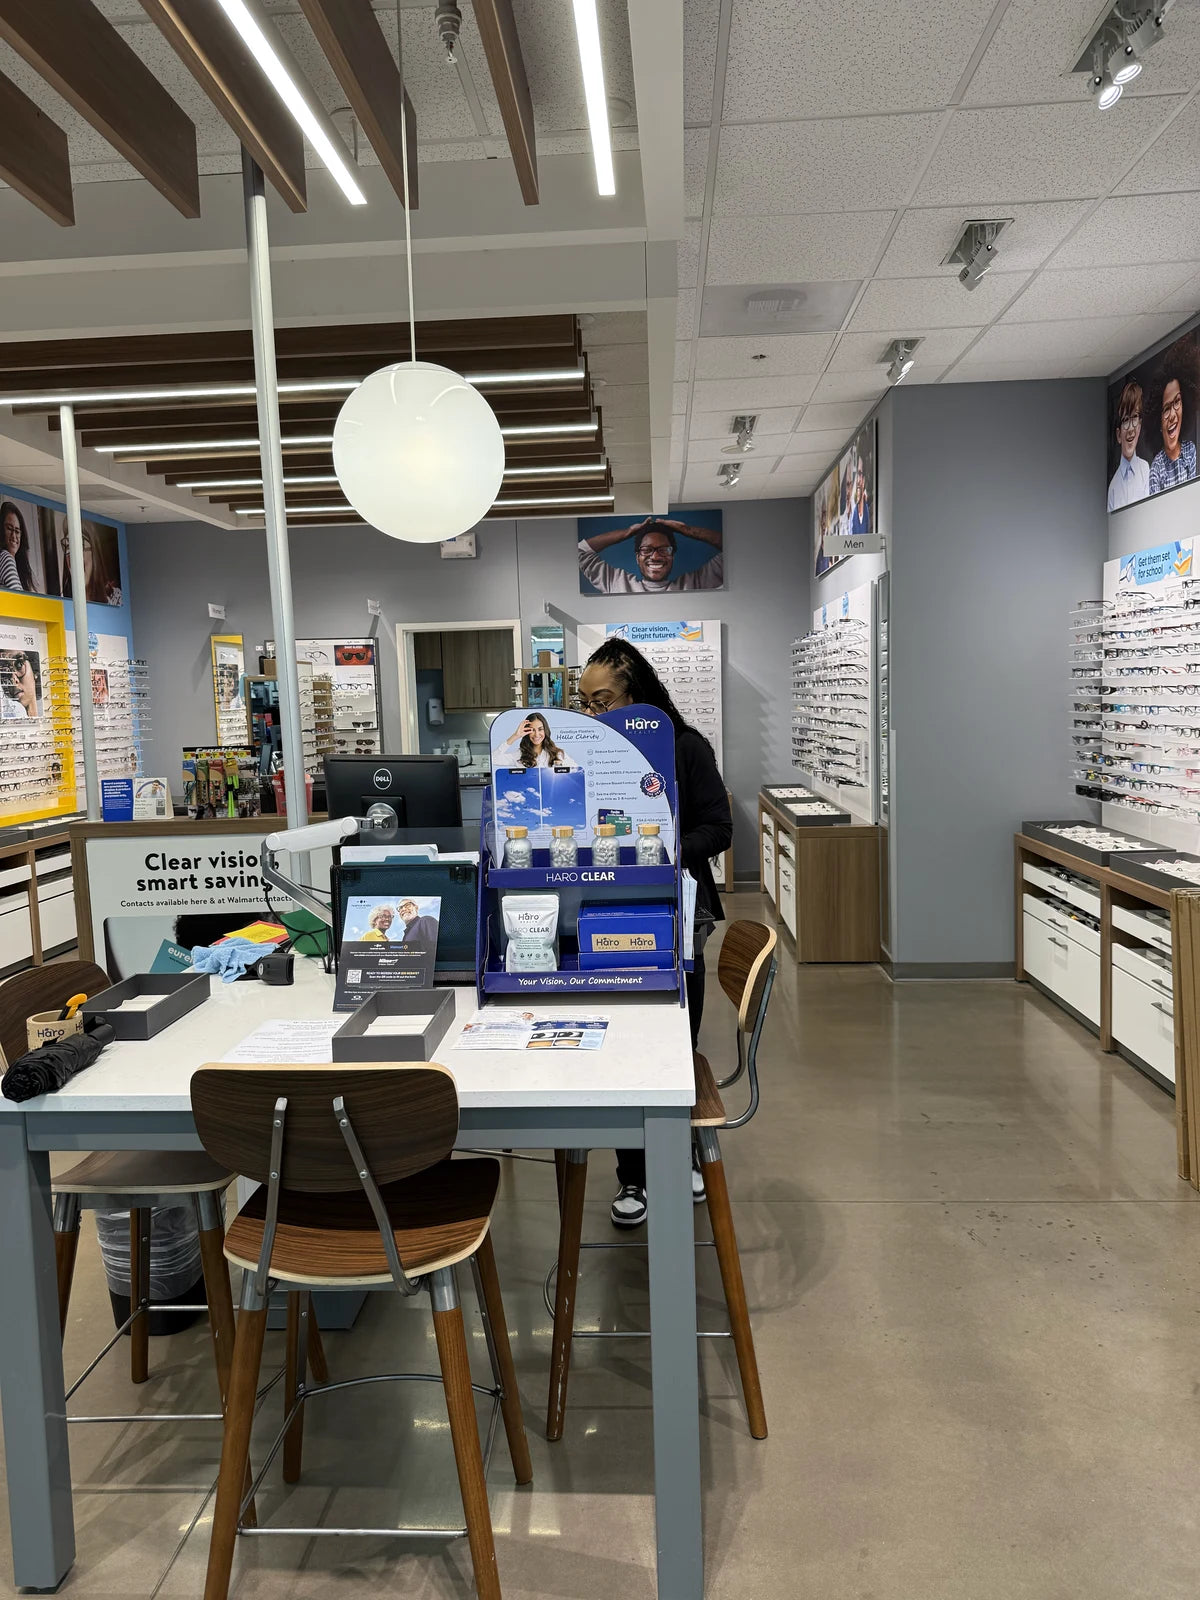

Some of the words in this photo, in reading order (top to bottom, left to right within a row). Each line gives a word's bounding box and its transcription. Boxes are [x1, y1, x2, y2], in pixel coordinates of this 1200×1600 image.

[844, 540, 864, 548] Men
[1138, 557, 1147, 567] Get
[1148, 554, 1161, 564] them
[1162, 551, 1170, 561] set
[1146, 564, 1163, 577] school
[625, 718, 659, 730] Haro
[145, 853, 202, 870] Clear
[208, 850, 279, 869] visio,
[136, 874, 198, 891] smart
[546, 873, 578, 882] HARO
[581, 872, 615, 881] CLEAR
[596, 938, 619, 946] Haro
[630, 937, 653, 946] Haro
[168, 947, 193, 963] eure
[518, 978, 537, 986] Your
[540, 977, 567, 986] Vision,
[588, 976, 643, 985] Commitment
[37, 1028, 65, 1037] Haro
